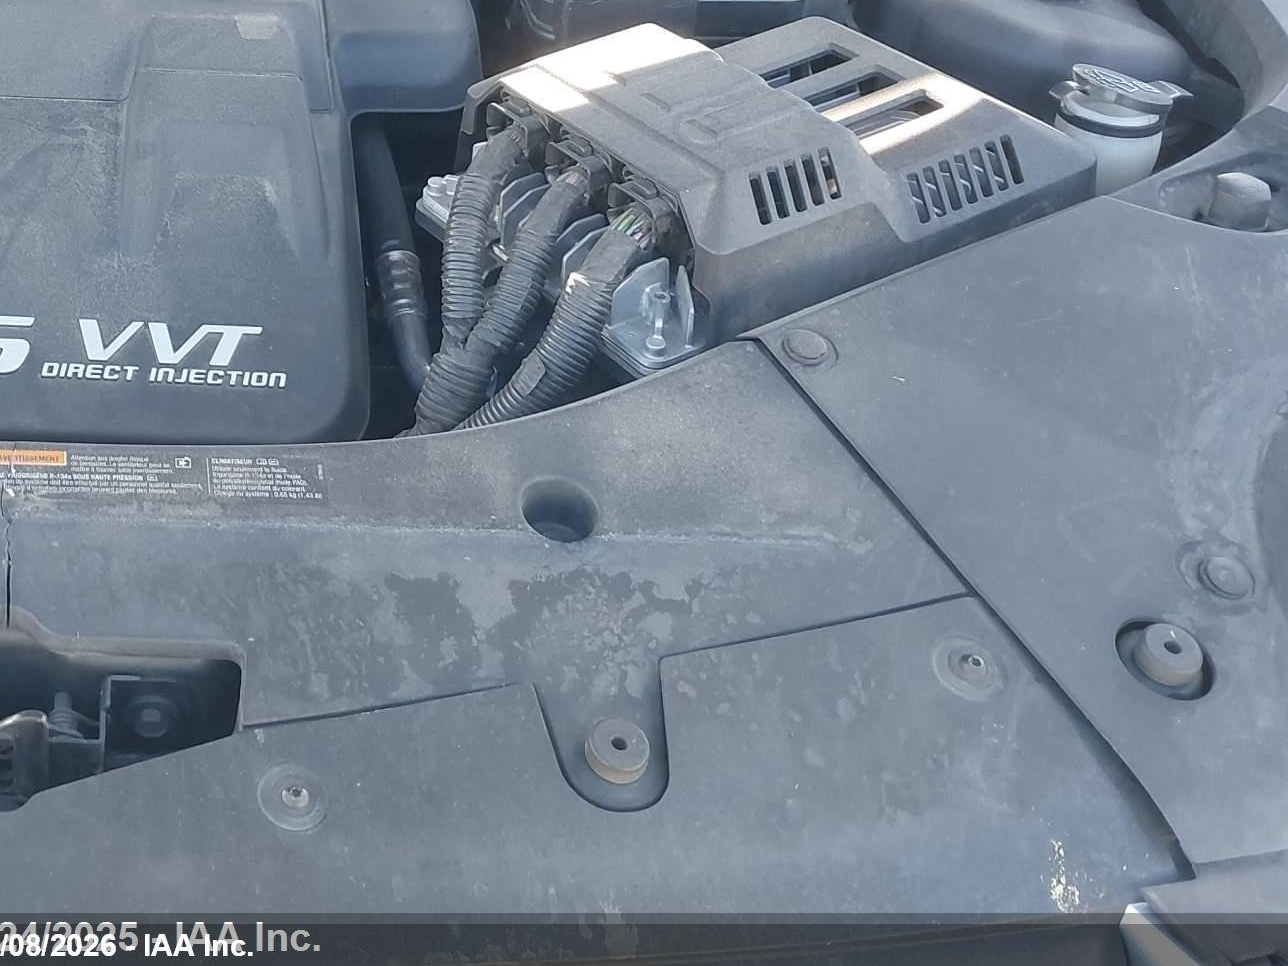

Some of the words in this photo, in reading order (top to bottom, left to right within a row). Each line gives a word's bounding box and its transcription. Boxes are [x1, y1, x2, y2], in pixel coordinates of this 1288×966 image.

[78, 318, 263, 367] VVT
[40, 360, 140, 381] DIRECT
[148, 367, 287, 388] INJECTION
